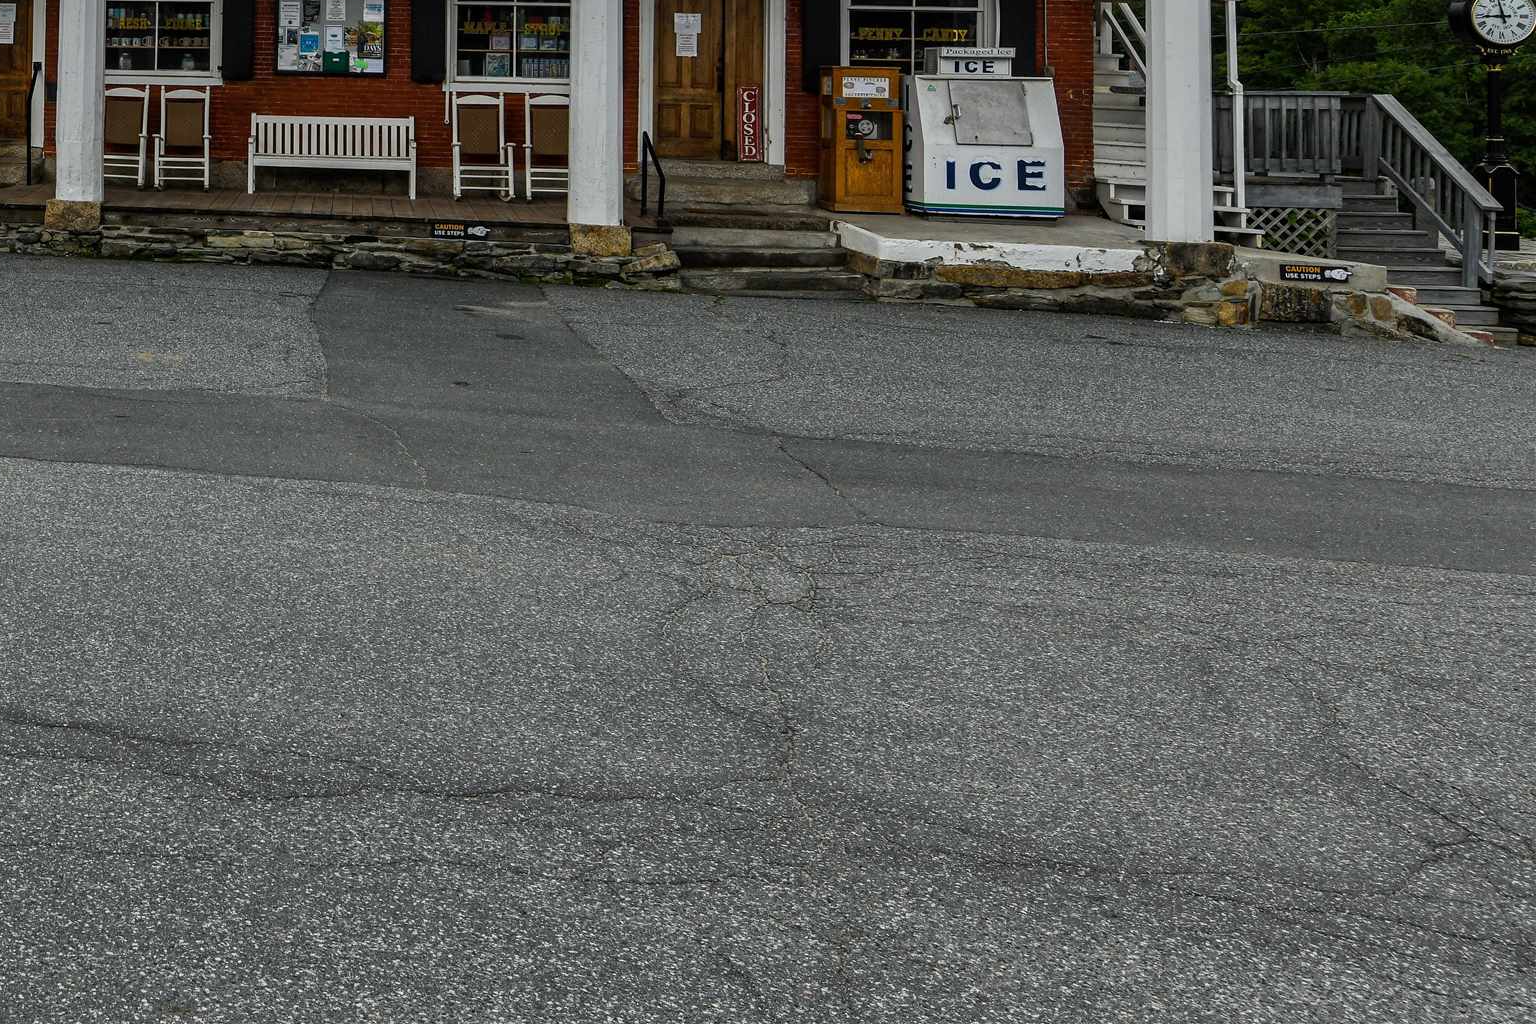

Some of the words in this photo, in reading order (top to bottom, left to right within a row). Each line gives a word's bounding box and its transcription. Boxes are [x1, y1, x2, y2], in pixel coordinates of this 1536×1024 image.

[858, 26, 904, 41] PENNY
[922, 26, 969, 42] CANDY
[945, 48, 994, 56] Packaged
[997, 48, 1013, 56] Ice
[954, 60, 995, 74] ICE
[742, 90, 756, 156] CLOSED
[946, 159, 1047, 191] ICE
[1285, 265, 1321, 274] CAUTION
[1301, 272, 1322, 280] STEPS
